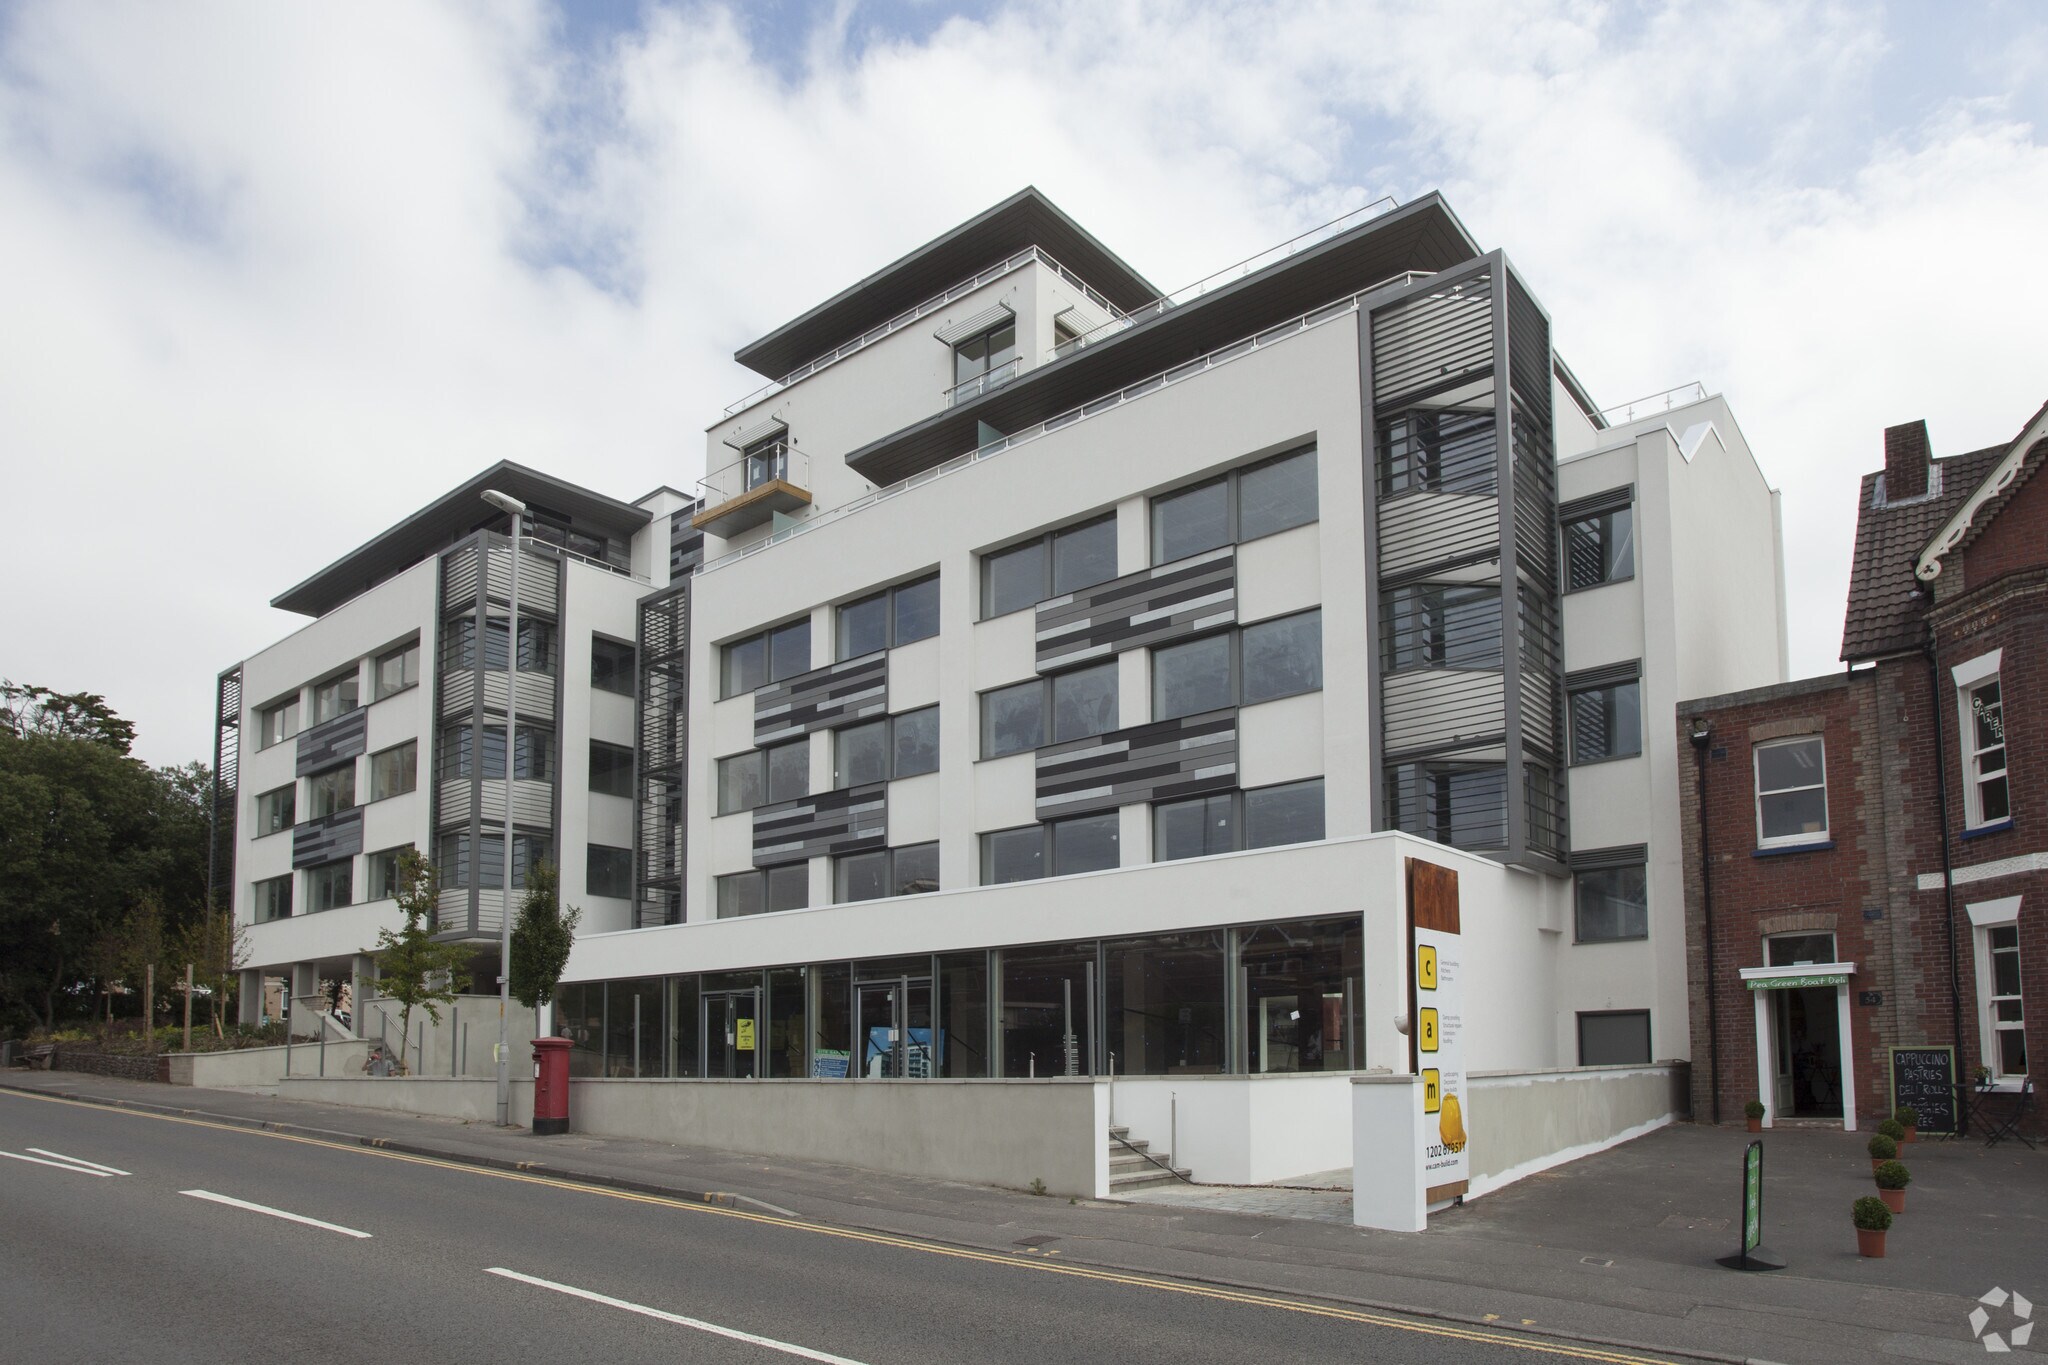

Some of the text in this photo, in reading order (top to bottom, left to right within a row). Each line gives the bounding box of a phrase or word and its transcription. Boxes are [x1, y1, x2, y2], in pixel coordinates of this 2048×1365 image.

[1425, 959, 1431, 977] c
[1750, 976, 1846, 989] Pea Green Boat Deli
[1426, 1021, 1432, 1039] a
[1895, 1053, 1949, 1065] CAPPUCCINO
[1904, 1068, 1943, 1080] PASTRIES
[1427, 1083, 1436, 1099] m
